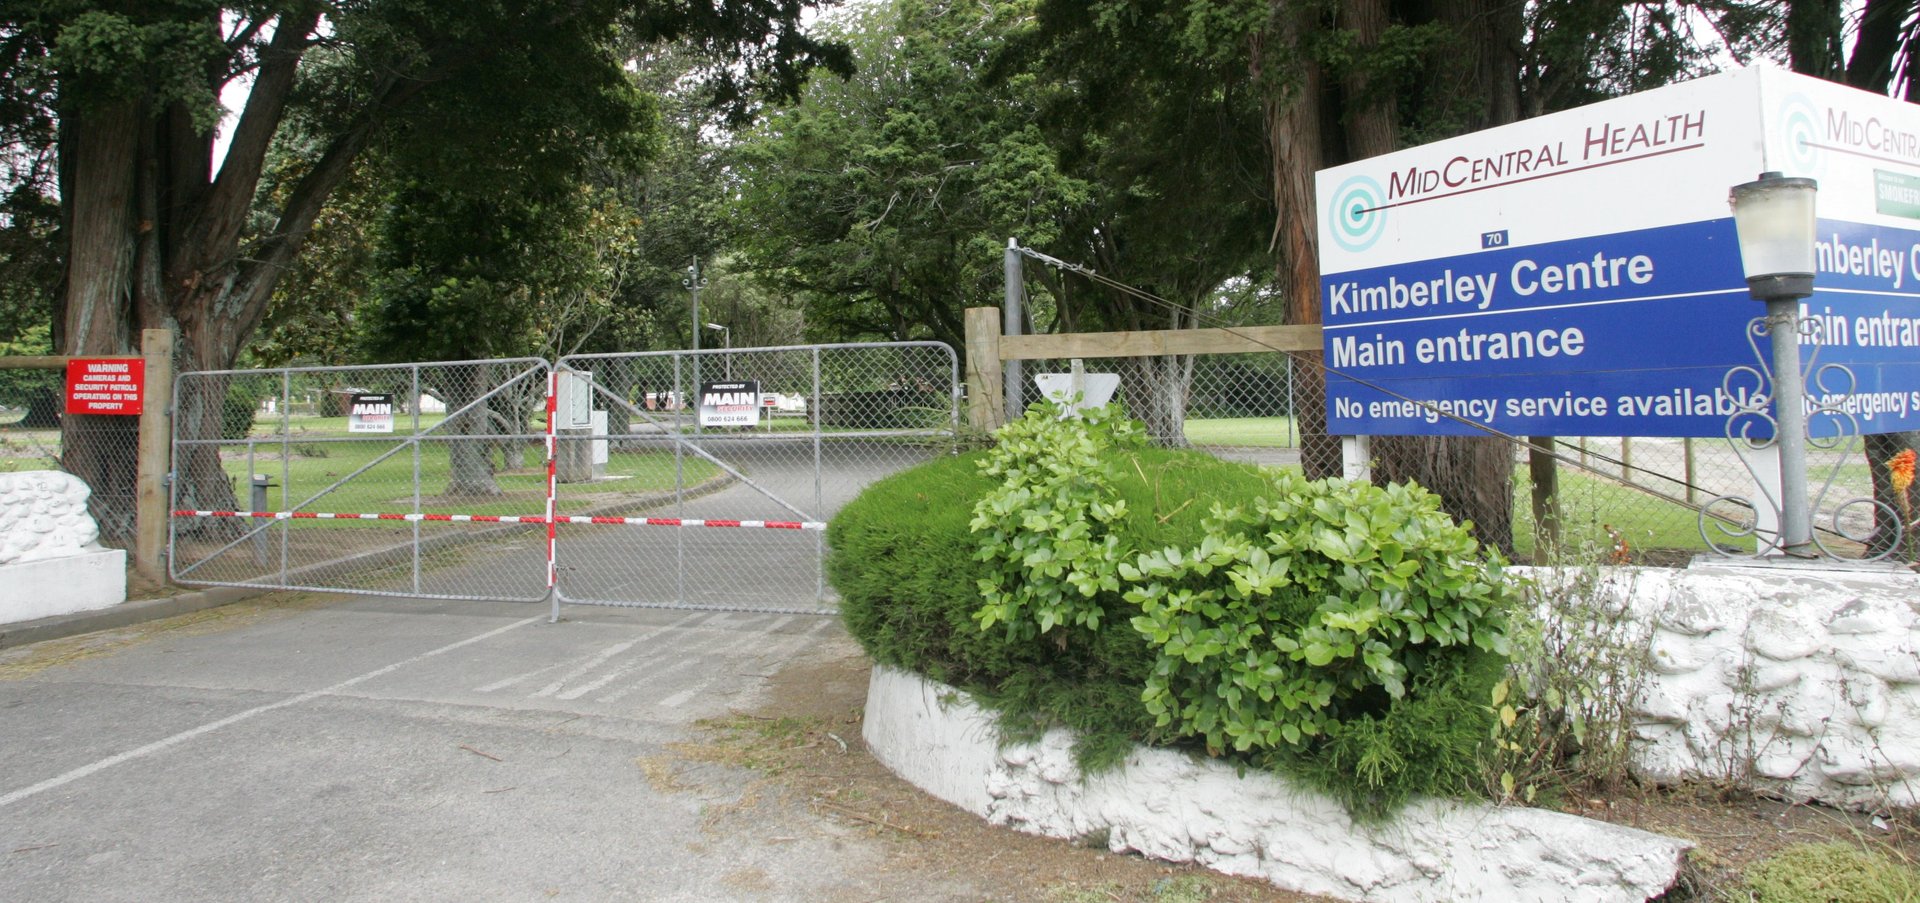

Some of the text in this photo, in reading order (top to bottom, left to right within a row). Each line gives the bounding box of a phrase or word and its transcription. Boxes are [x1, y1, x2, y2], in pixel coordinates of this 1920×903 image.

[1582, 109, 1706, 162] HEALTH
[1486, 232, 1502, 246] 70
[1814, 232, 1904, 289] mberley
[1329, 251, 1654, 316] Kimberley Centre
[1332, 326, 1585, 368] Main entrance
[87, 363, 129, 373] WARNING
[83, 374, 131, 382] CAMERAS AND
[74, 383, 137, 392] SECURITY PATROLS
[73, 392, 111, 400] OPERATING
[123, 393, 138, 401] THIS
[704, 392, 755, 406] MAIN
[88, 402, 123, 410] PROPERTY
[352, 403, 392, 415] MAIN
[1335, 386, 1769, 423] No emergency service available
[1821, 391, 1908, 421] emergency
